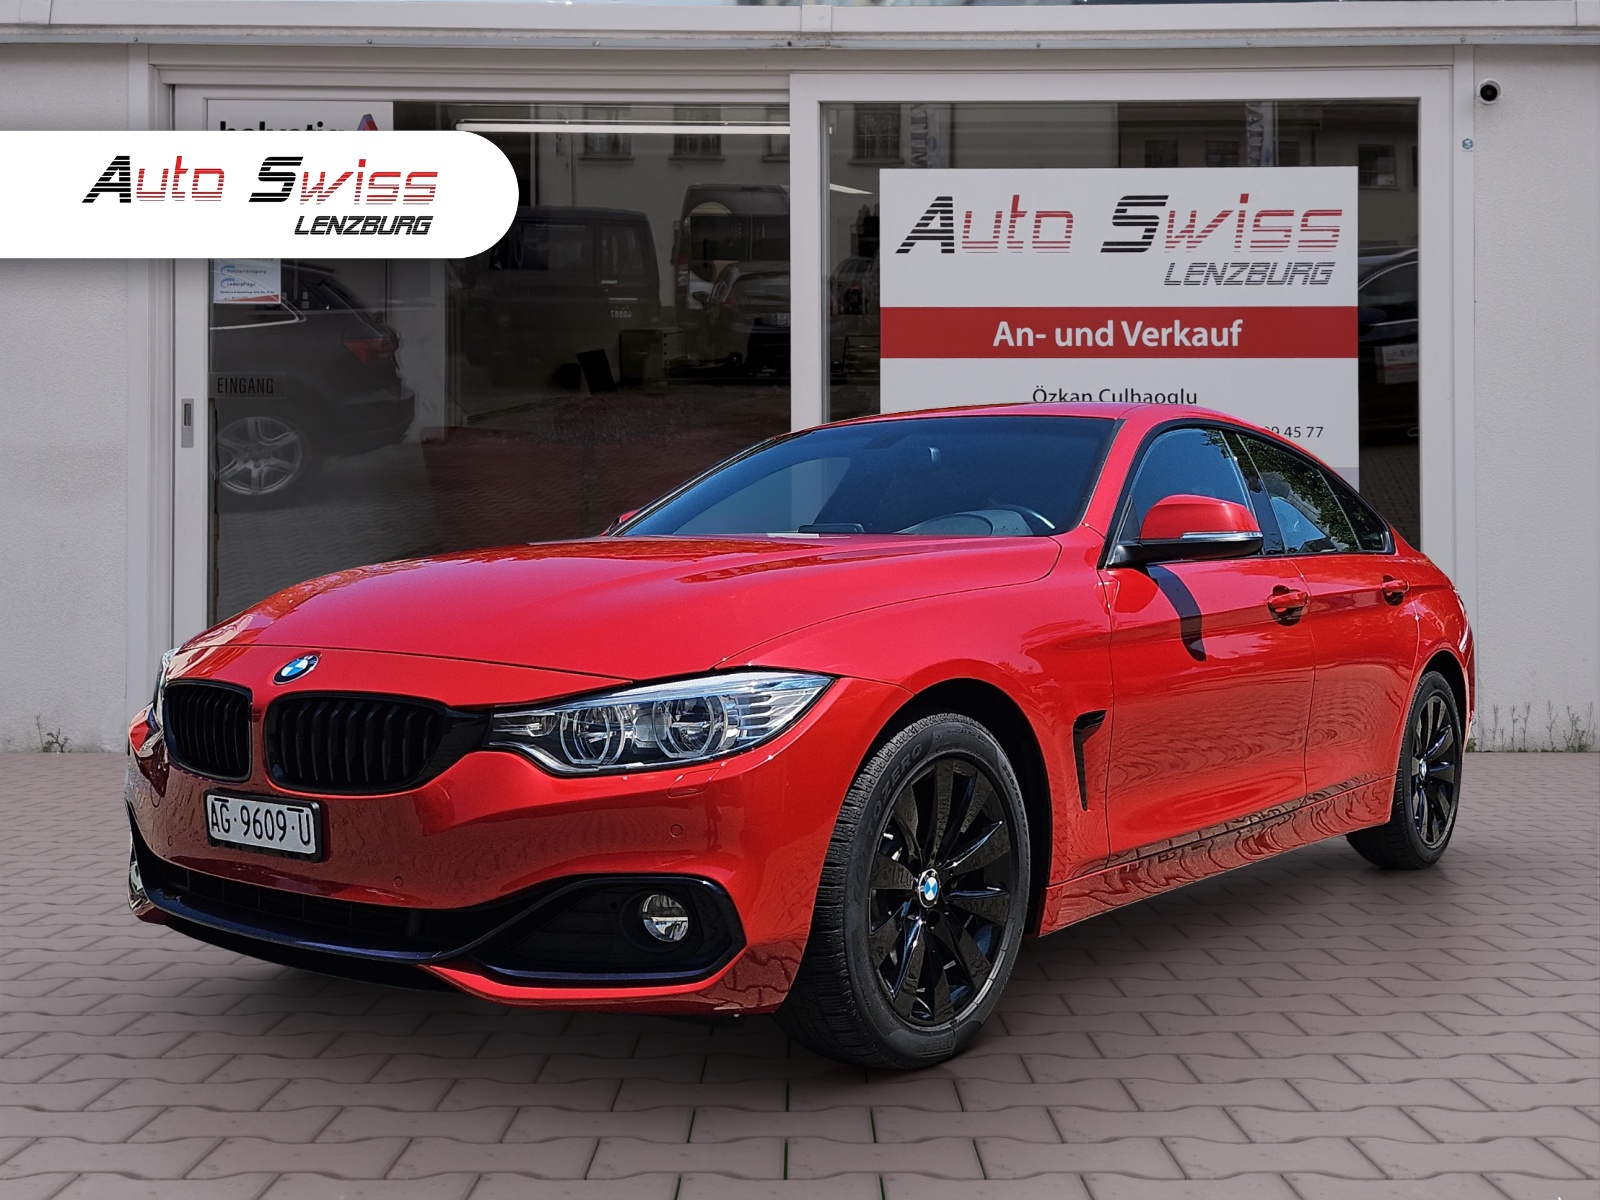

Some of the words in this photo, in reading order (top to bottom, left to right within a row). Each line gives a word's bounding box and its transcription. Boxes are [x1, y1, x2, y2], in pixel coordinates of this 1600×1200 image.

[895, 194, 1074, 254] Auto
[1100, 193, 1343, 254] Swiss
[1163, 261, 1336, 286] LENZBURG
[992, 320, 1047, 348] An-
[1054, 319, 1115, 348] und
[1120, 319, 1244, 348] Verkauf
[217, 377, 274, 394] EINGANG
[1032, 385, 1092, 403] Özkan
[1283, 426, 1302, 439] 45
[1306, 426, 1324, 439] 77
